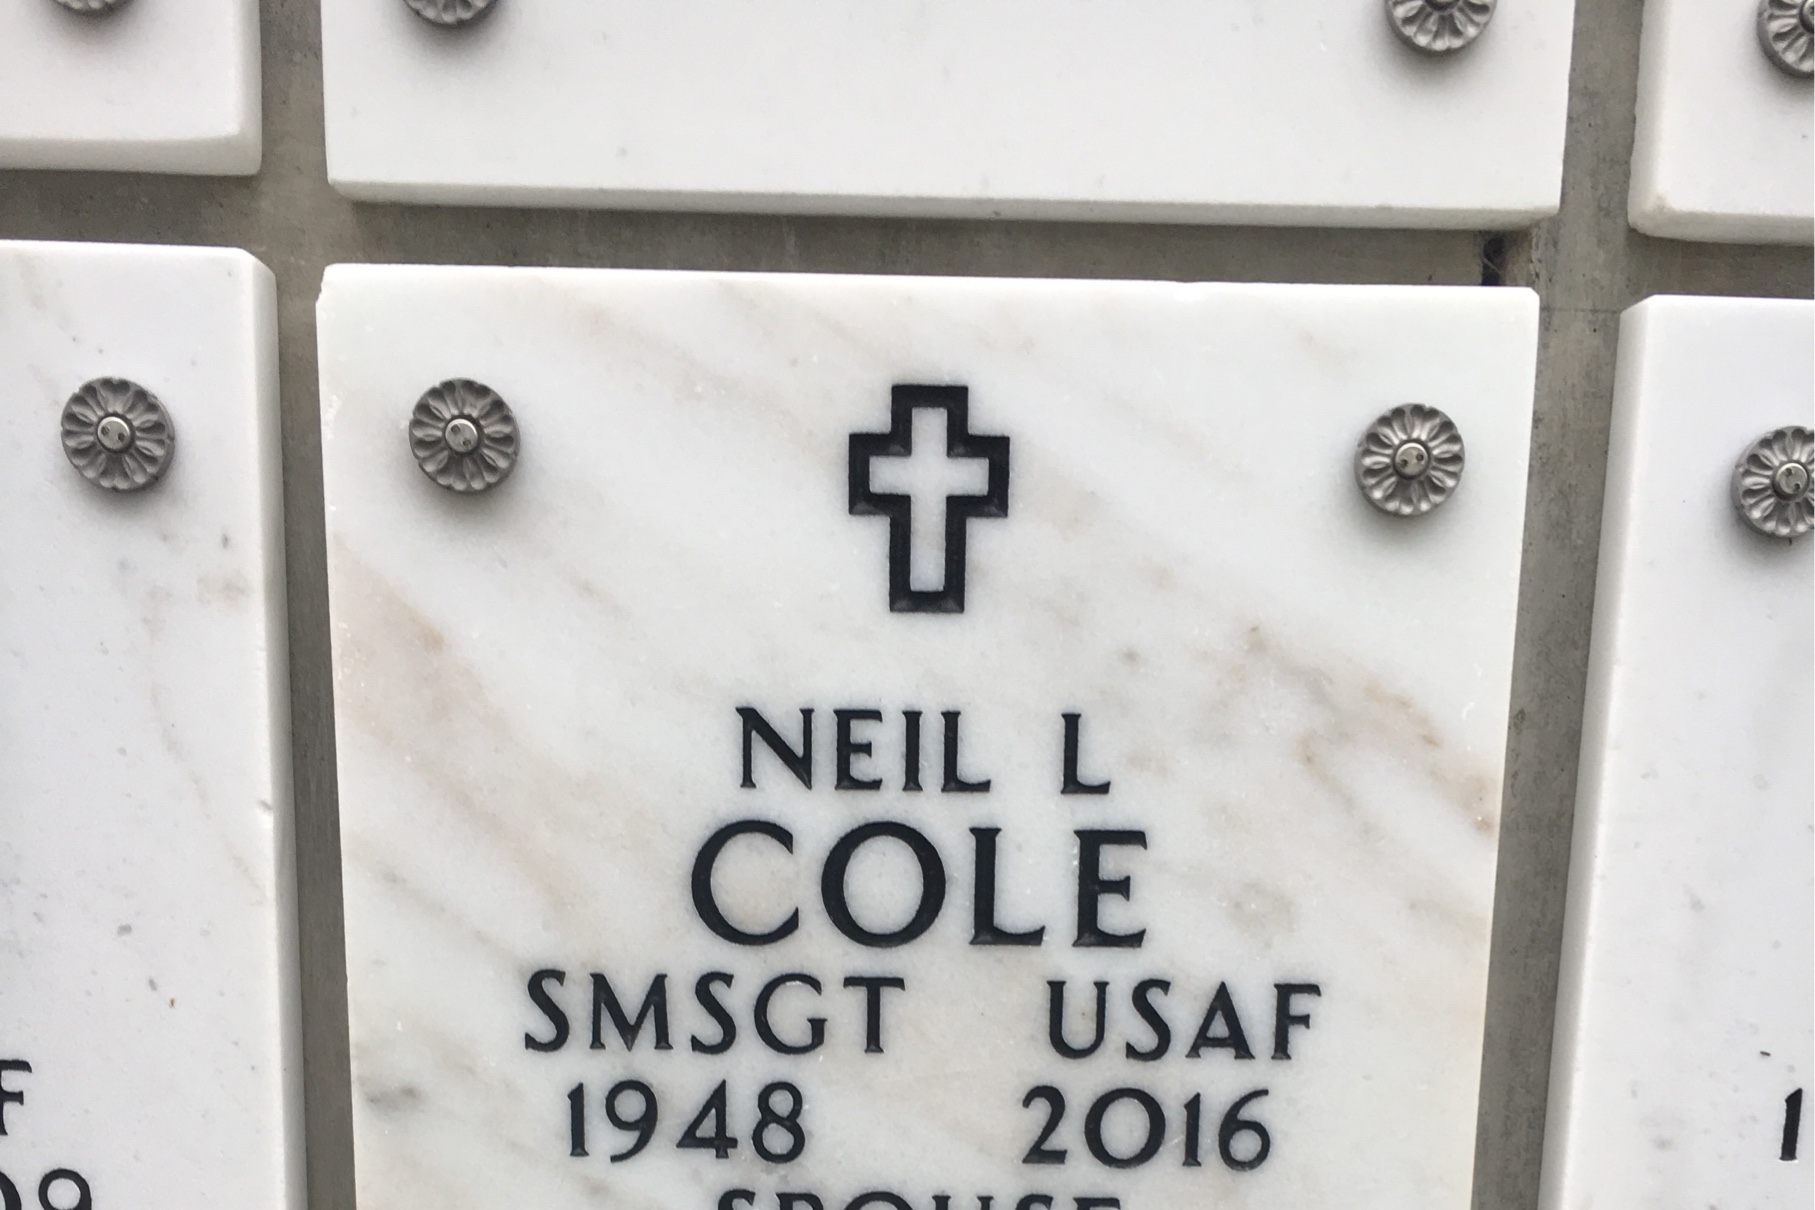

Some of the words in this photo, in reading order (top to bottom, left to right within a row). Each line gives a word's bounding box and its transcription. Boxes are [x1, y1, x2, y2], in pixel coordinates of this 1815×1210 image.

[735, 706, 992, 794] NEIL
[1060, 712, 1112, 796] L
[690, 818, 1148, 950] COLE
[524, 968, 906, 1056] SMSGT
[1046, 977, 1322, 1063] USAF
[567, 1078, 806, 1165] 1948
[1021, 1084, 1271, 1172] 2016
